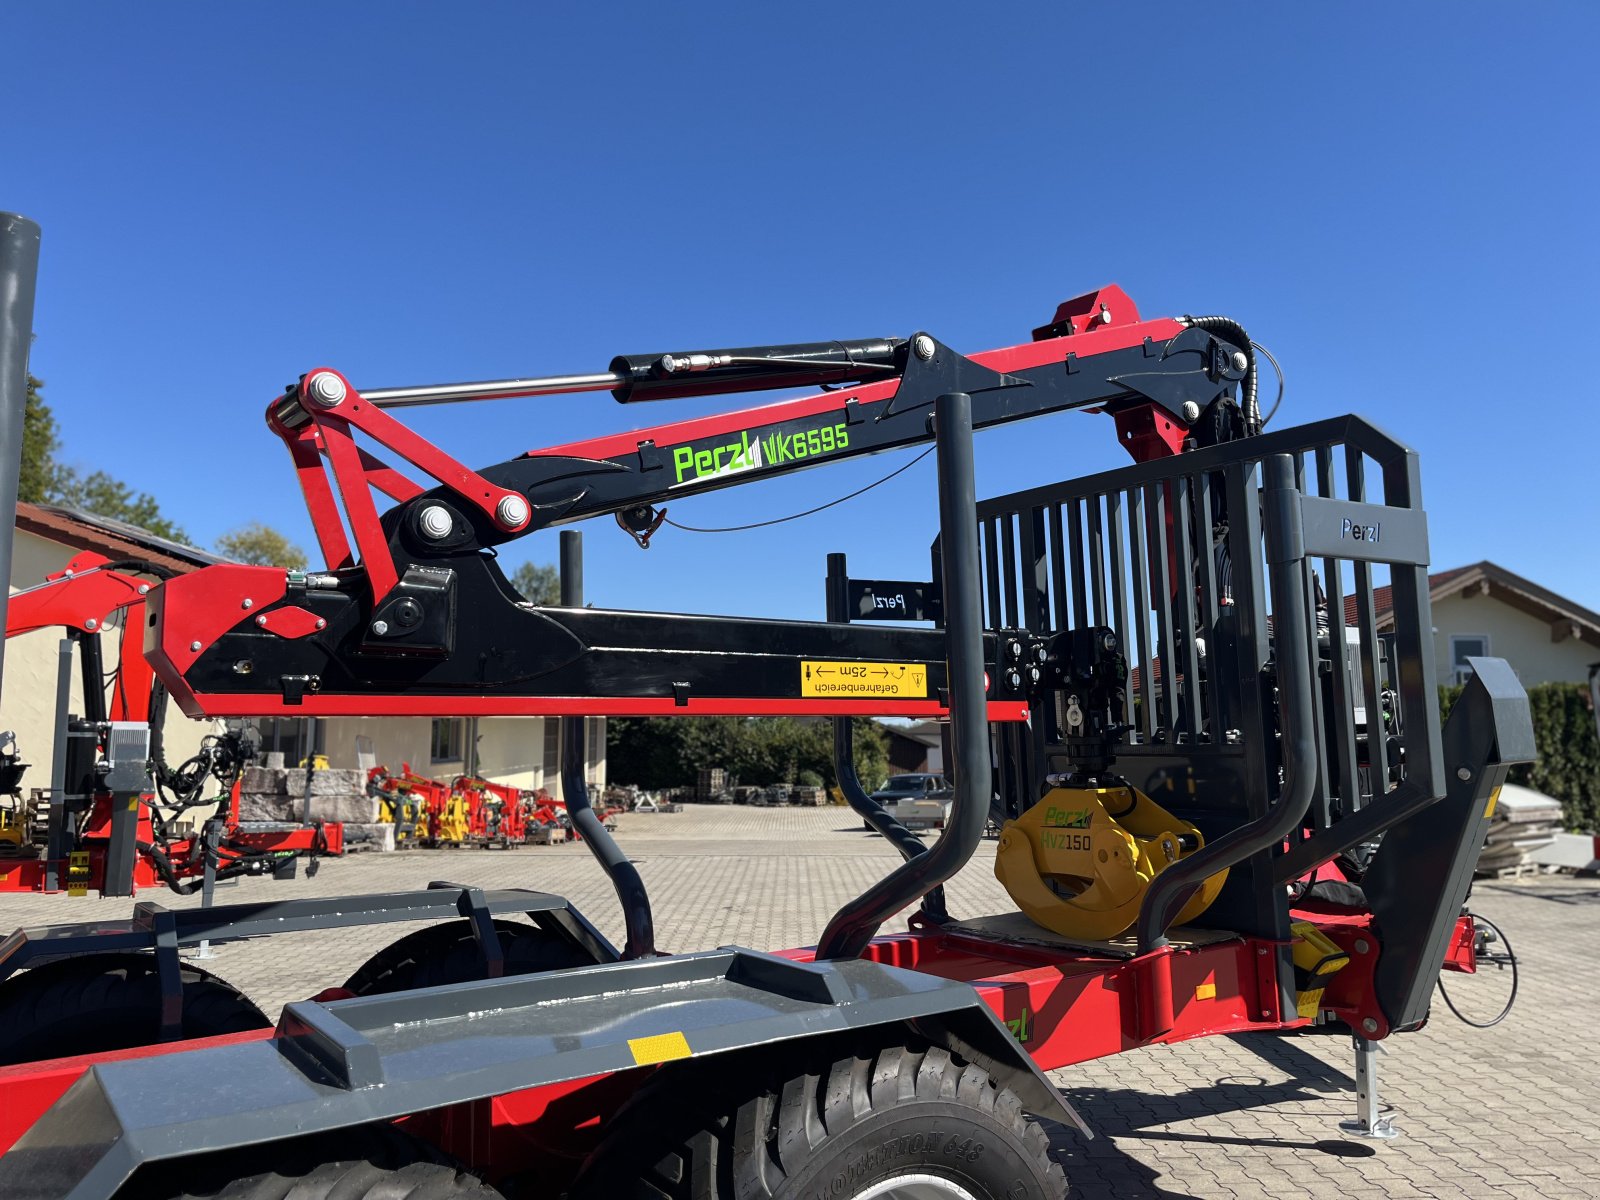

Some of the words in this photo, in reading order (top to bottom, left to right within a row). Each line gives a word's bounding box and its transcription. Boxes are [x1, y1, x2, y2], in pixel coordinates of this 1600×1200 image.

[673, 430, 754, 483] Perzl
[1340, 518, 1380, 542] Perzl
[840, 666, 867, 678] 25m
[814, 683, 899, 694] Gefahrenbereich
[1044, 806, 1089, 828] Perzl
[1040, 831, 1091, 851] HVZ150
